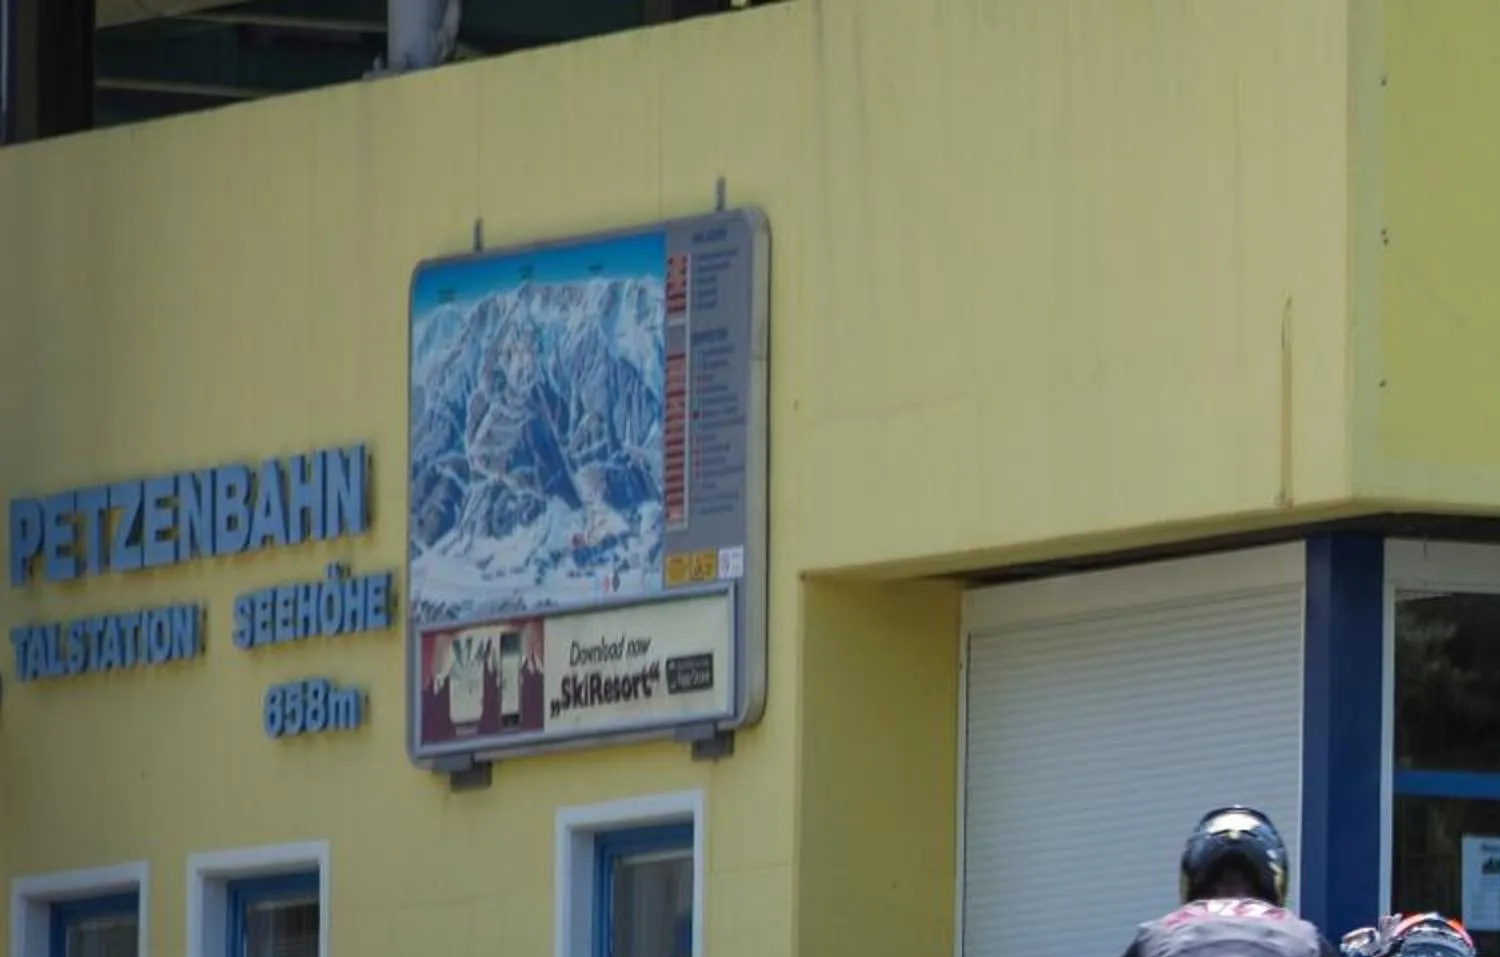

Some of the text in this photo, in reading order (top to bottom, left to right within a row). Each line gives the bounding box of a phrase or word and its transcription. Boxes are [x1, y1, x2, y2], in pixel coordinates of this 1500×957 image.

[10, 443, 368, 588] PETZENBAHN
[10, 562, 392, 680] TALSTATION SEEHÖHE
[570, 632, 653, 667] Download now
[265, 678, 361, 738] 658m
